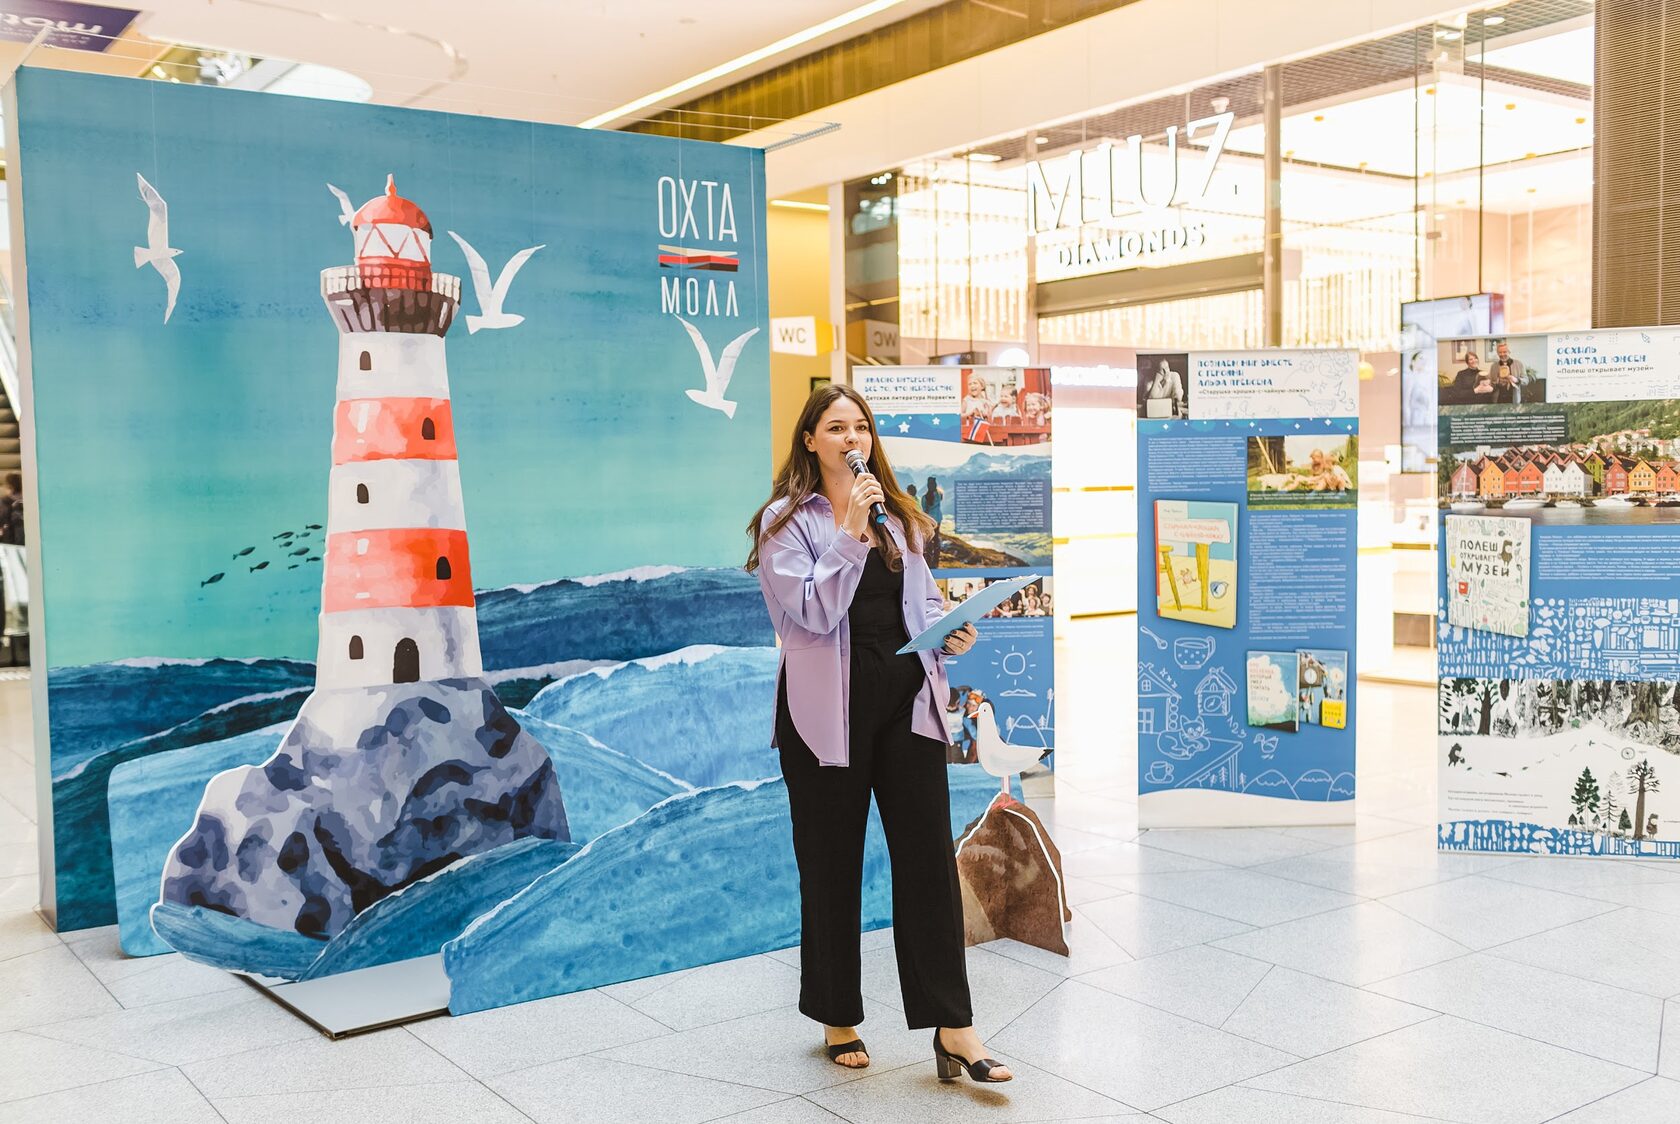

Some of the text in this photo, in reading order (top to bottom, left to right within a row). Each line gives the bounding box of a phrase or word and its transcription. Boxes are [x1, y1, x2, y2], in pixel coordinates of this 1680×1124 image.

[657, 176, 738, 243] ОХТА
[1056, 223, 1207, 267] DIAMONDS
[660, 276, 740, 318] МОЛЛ
[778, 326, 808, 344] WC
[1556, 346, 1597, 355] ОСХИЛЬ
[1611, 355, 1647, 363] ЮНСЕН
[1460, 539, 1498, 552] ПОЛЕШ
